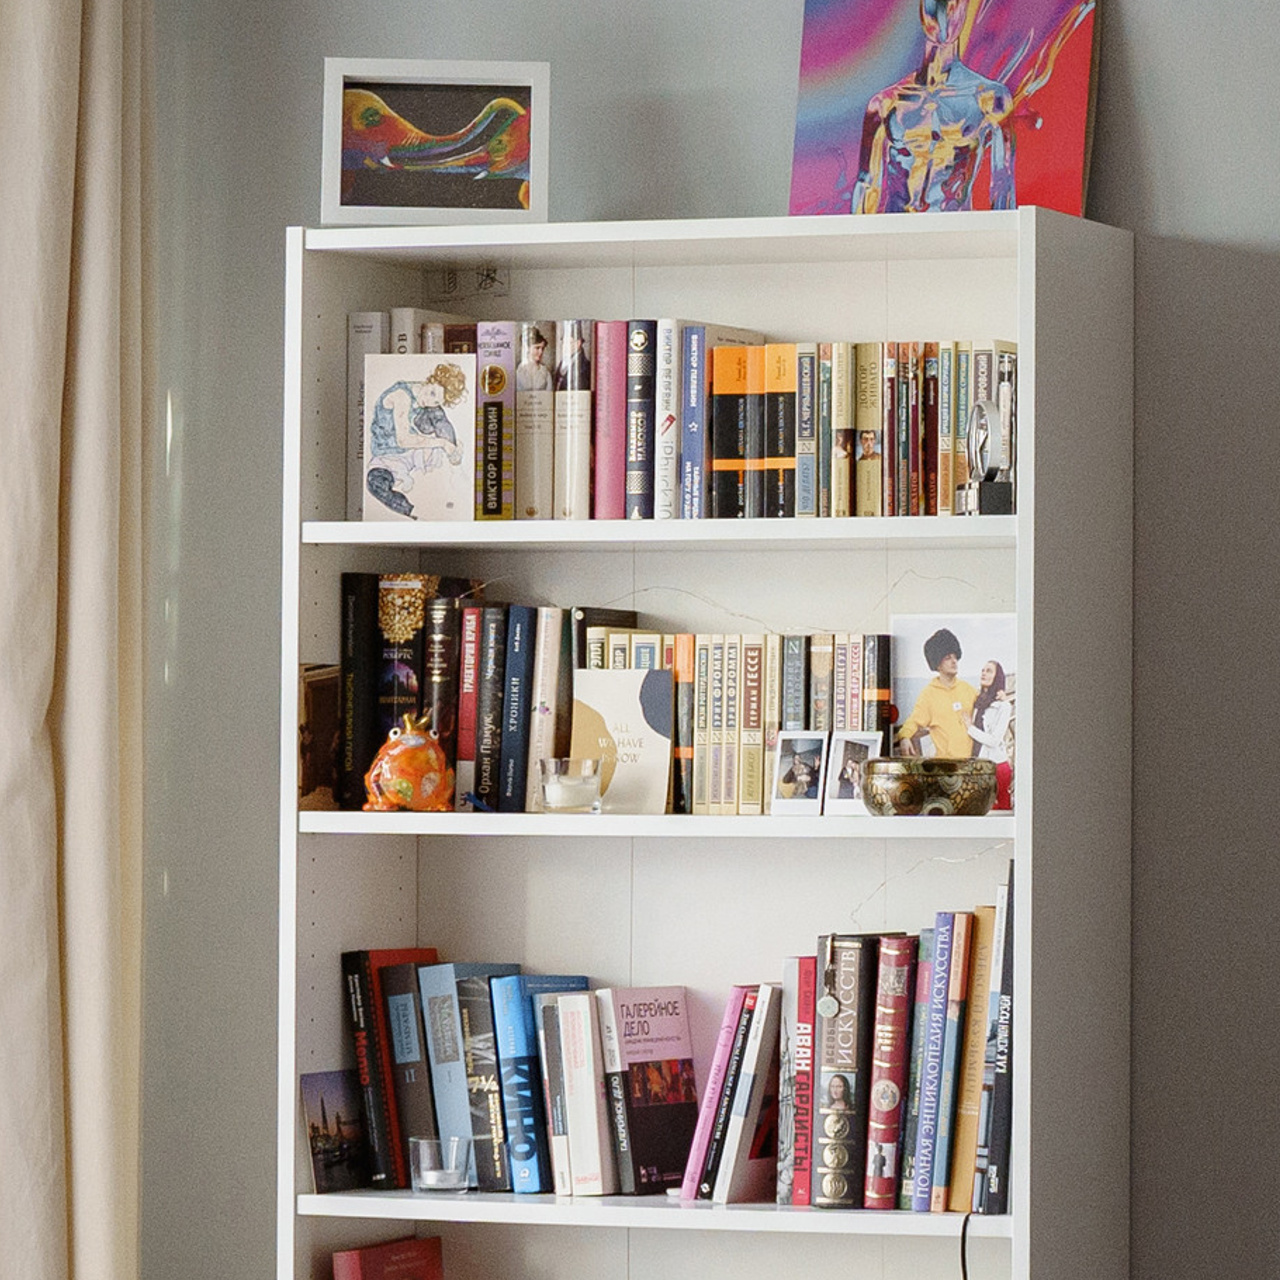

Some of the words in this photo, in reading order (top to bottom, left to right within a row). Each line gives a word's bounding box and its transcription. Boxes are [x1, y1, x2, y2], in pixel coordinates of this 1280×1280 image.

[690, 334, 698, 367] ВИКТОР
[690, 369, 698, 407] ПЕЛЕВИН
[859, 365, 869, 409] ДОКТОР
[868, 362, 878, 409] ЖИВАГО
[486, 407, 498, 461] ПЕЛЕВИН
[486, 463, 498, 510] ВИКТОР
[465, 614, 476, 642] КРАБА
[487, 623, 496, 648] книга
[463, 643, 475, 693] ТРАЕКТОРИЯ
[485, 648, 496, 680] Черная
[713, 648, 722, 697] ФРОММ
[727, 648, 737, 697] ФРОММ
[747, 649, 759, 687] ГЕССЕ
[836, 648, 846, 700] ВОННЕГУТ
[508, 677, 520, 732] ХРОНИКИ
[713, 701, 722, 727] ЭРИХ
[728, 700, 736, 726] ЭРИХ
[749, 689, 757, 727] ГЕРМАН
[836, 704, 846, 728] КУРТ
[480, 716, 494, 754] Памук
[618, 737, 645, 748] HAVE
[479, 757, 492, 794] Орхан
[927, 924, 951, 1010] ИСКУССТВА
[973, 942, 988, 1014] АЛЕКСЕЙ
[620, 998, 681, 1019] ГАЛЕРЕЙНОЕ
[623, 1020, 650, 1037] ДЕЛО
[836, 951, 854, 1065] ИСКУССТВ
[996, 994, 1010, 1025] МУЗЕЙ
[354, 1030, 371, 1086] Memo
[920, 1013, 943, 1135] ЭНЦИКЛОПЕДИЯ
[965, 1018, 982, 1095] КУЗЬМИЧ
[993, 1055, 1007, 1074] КАК
[501, 1056, 537, 1161] КИНО
[611, 1076, 622, 1099] ДЕЛО
[794, 1022, 812, 1172] АВАНГАРДИСТЫ
[614, 1101, 628, 1152] ГАЛЕРЕЙНОЕ
[916, 1139, 932, 1198] ПОЛНАЯ
